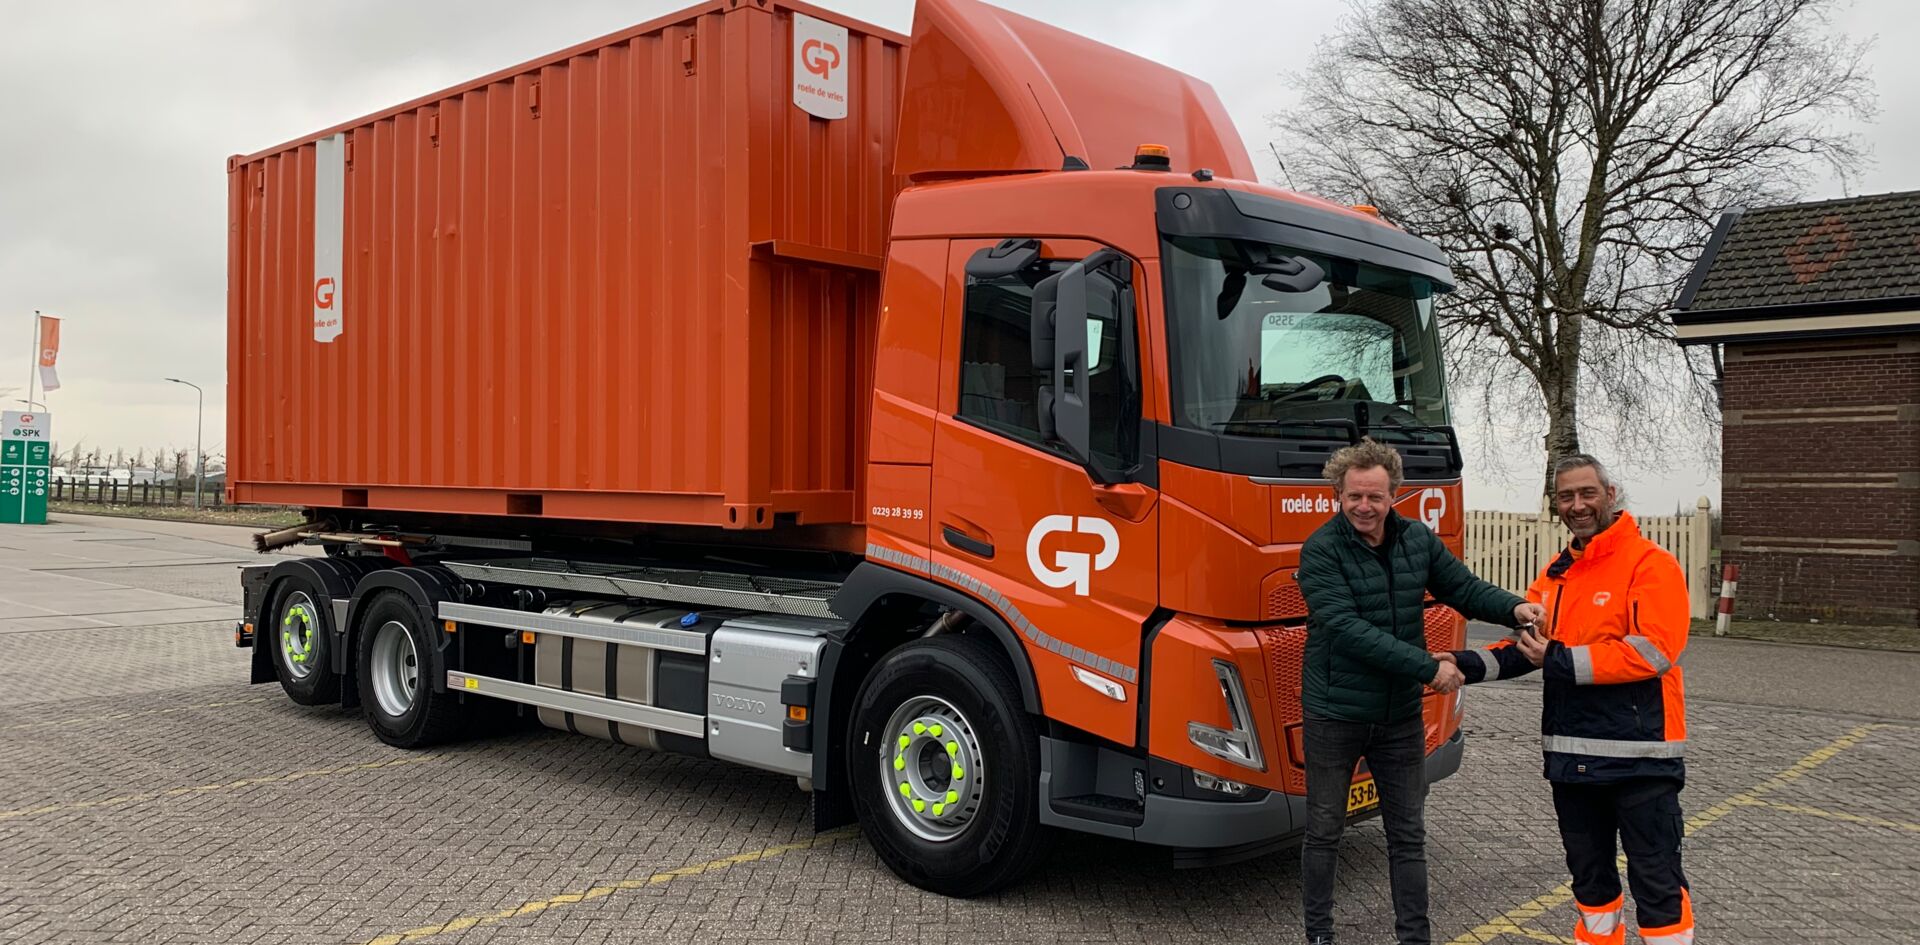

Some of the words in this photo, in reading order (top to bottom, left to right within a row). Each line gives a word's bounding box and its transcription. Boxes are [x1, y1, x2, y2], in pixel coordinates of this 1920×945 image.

[798, 84, 816, 94] roele
[817, 87, 826, 98] de
[827, 91, 844, 102] vries
[22, 429, 40, 437] SPK
[1281, 493, 1313, 513] roele
[1315, 493, 1330, 513] de
[872, 506, 890, 517] 0229
[891, 507, 901, 517] 28
[902, 508, 912, 519] 39
[913, 509, 923, 520] 99
[712, 693, 766, 715] VOLVO
[1350, 783, 1378, 806] 53-B
